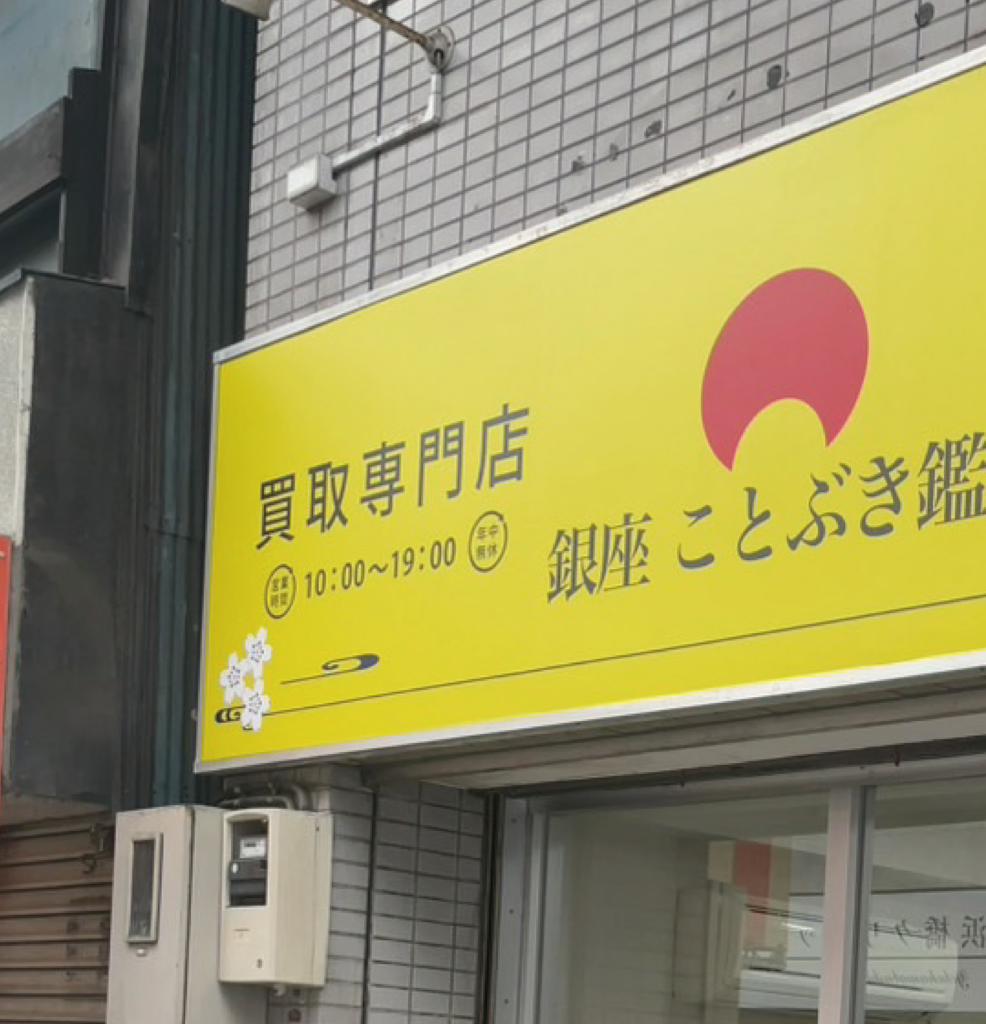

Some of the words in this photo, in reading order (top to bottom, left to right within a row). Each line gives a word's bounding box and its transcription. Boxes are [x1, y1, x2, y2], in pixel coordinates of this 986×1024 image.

[256, 403, 529, 550] 買取専門店
[547, 513, 654, 604] 銀座
